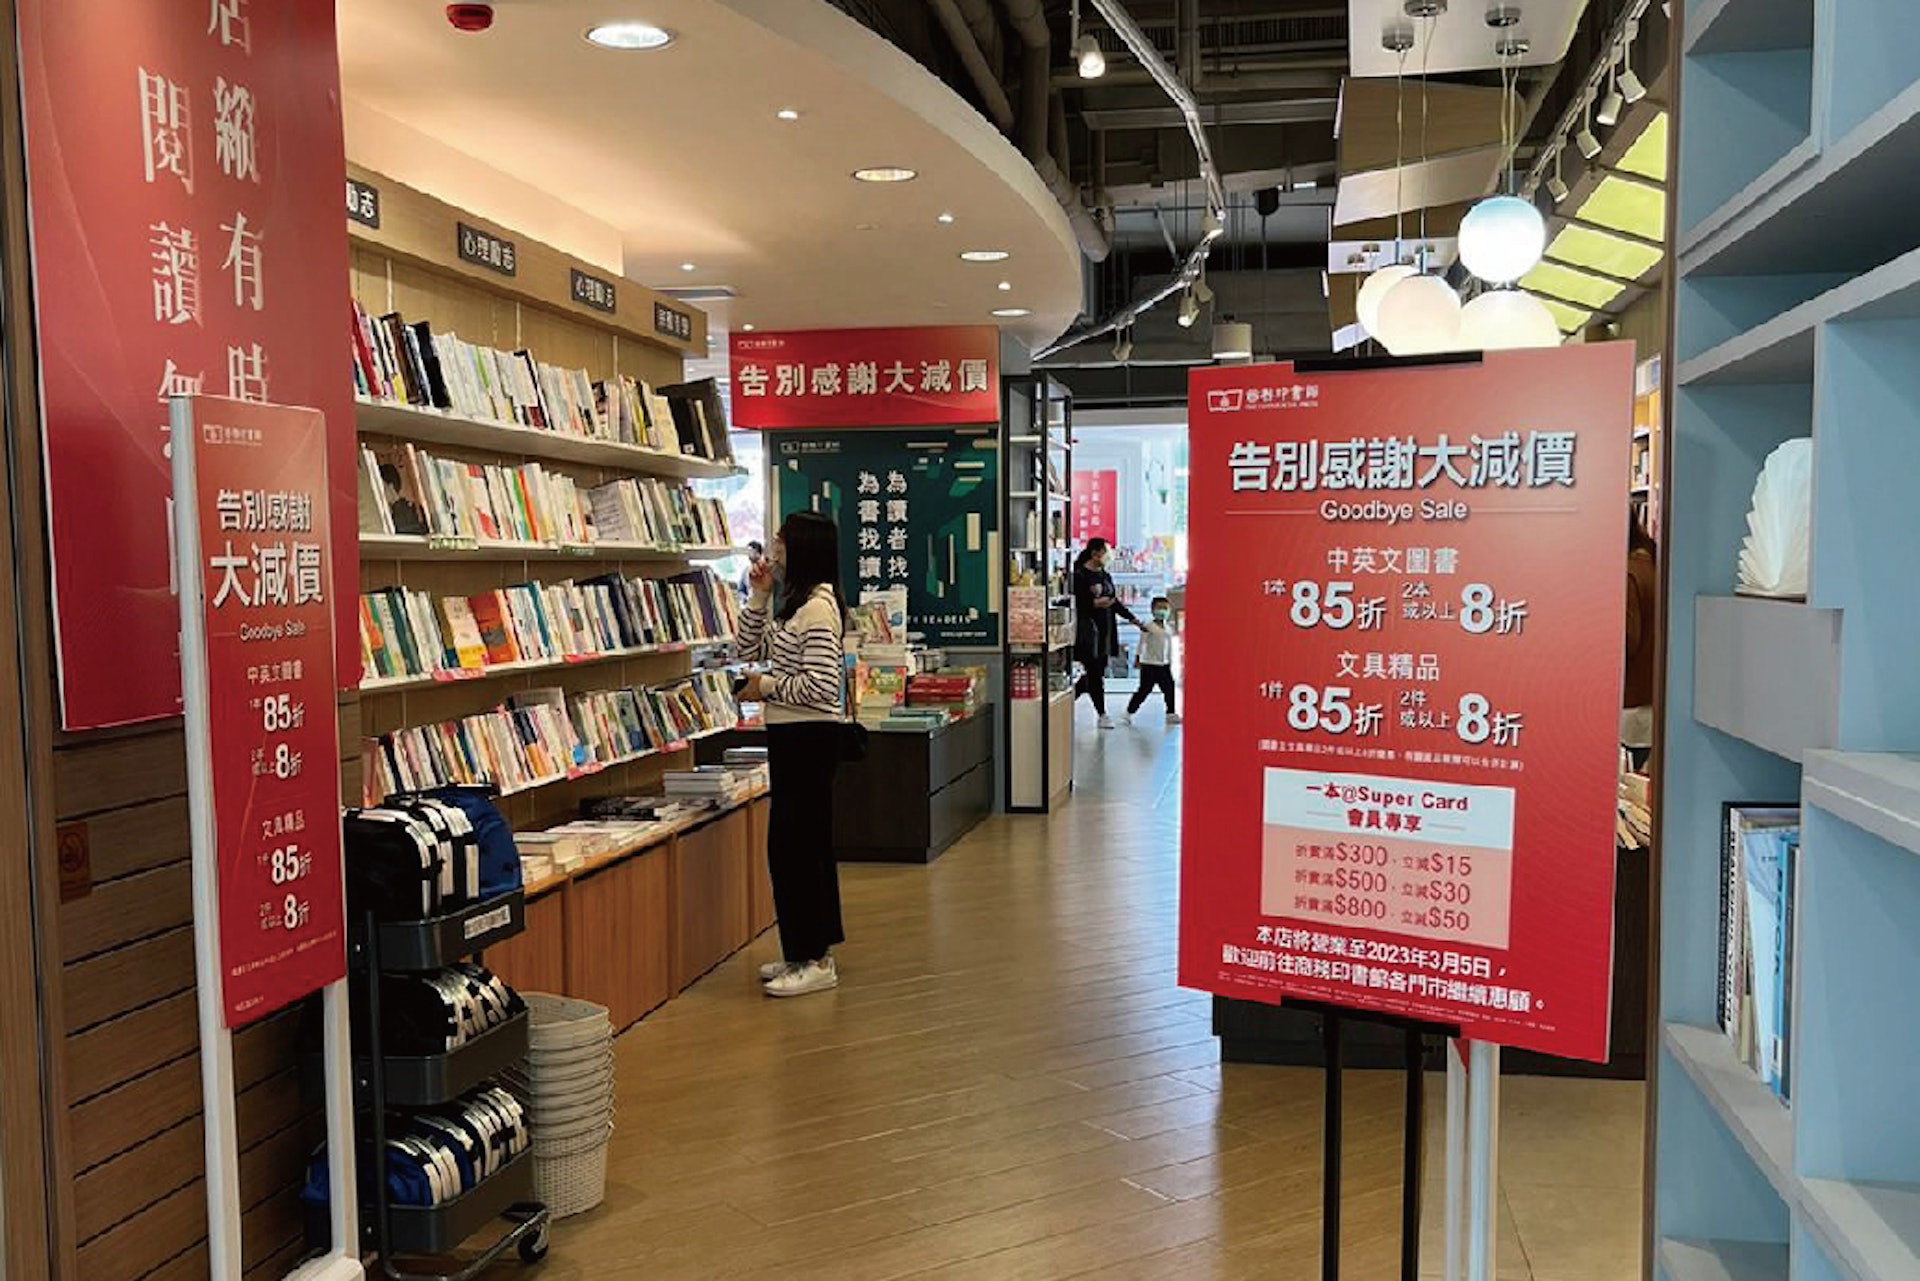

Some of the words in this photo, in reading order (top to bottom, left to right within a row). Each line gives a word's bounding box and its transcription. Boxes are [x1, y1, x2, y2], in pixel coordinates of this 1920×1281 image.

[738, 358, 989, 397] 告別感謝大減價
[1228, 430, 1577, 491] 告別感謝大減價
[216, 489, 311, 532] 告別感謝
[1320, 500, 1413, 525] Goodbye
[1420, 499, 1468, 521] Sale
[210, 541, 324, 607] 大減價
[1327, 547, 1460, 575] 中英文圖書
[240, 623, 283, 642] Goodbye
[247, 660, 302, 685] 中英文圖書
[1336, 651, 1440, 681] 文具精品
[1306, 781, 1415, 807] 一本@Super
[1421, 792, 1469, 811] Card
[262, 809, 306, 840] 文具精品
[1347, 808, 1422, 833] 會員專享
